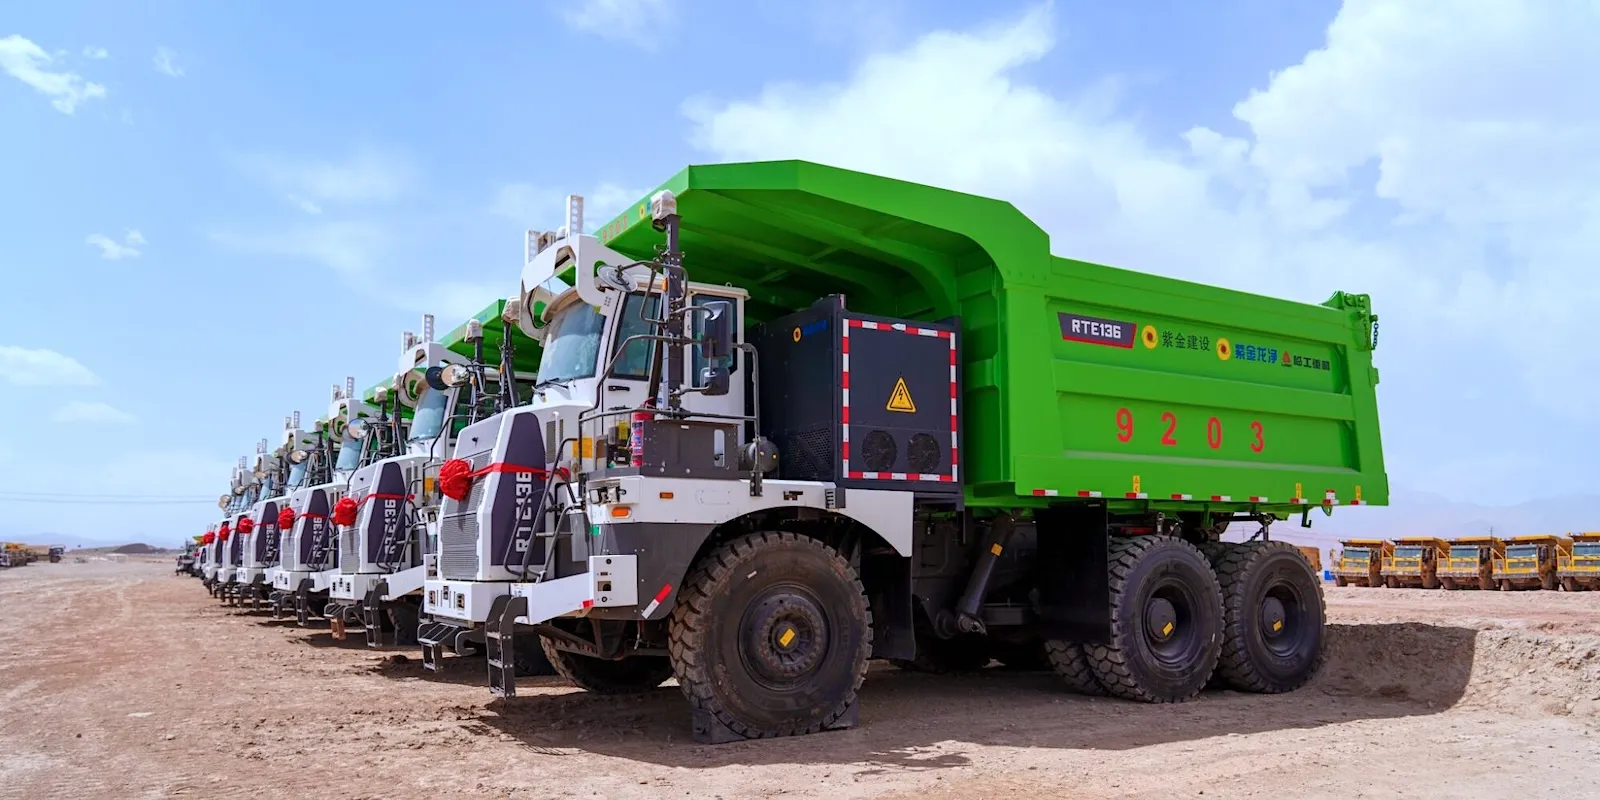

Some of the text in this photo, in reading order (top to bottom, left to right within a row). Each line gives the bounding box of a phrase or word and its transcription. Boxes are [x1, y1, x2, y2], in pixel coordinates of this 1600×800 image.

[1071, 318, 1121, 339] RTE136
[1162, 331, 1210, 351] 紫金建设
[1234, 343, 1278, 363] 紫金龙净
